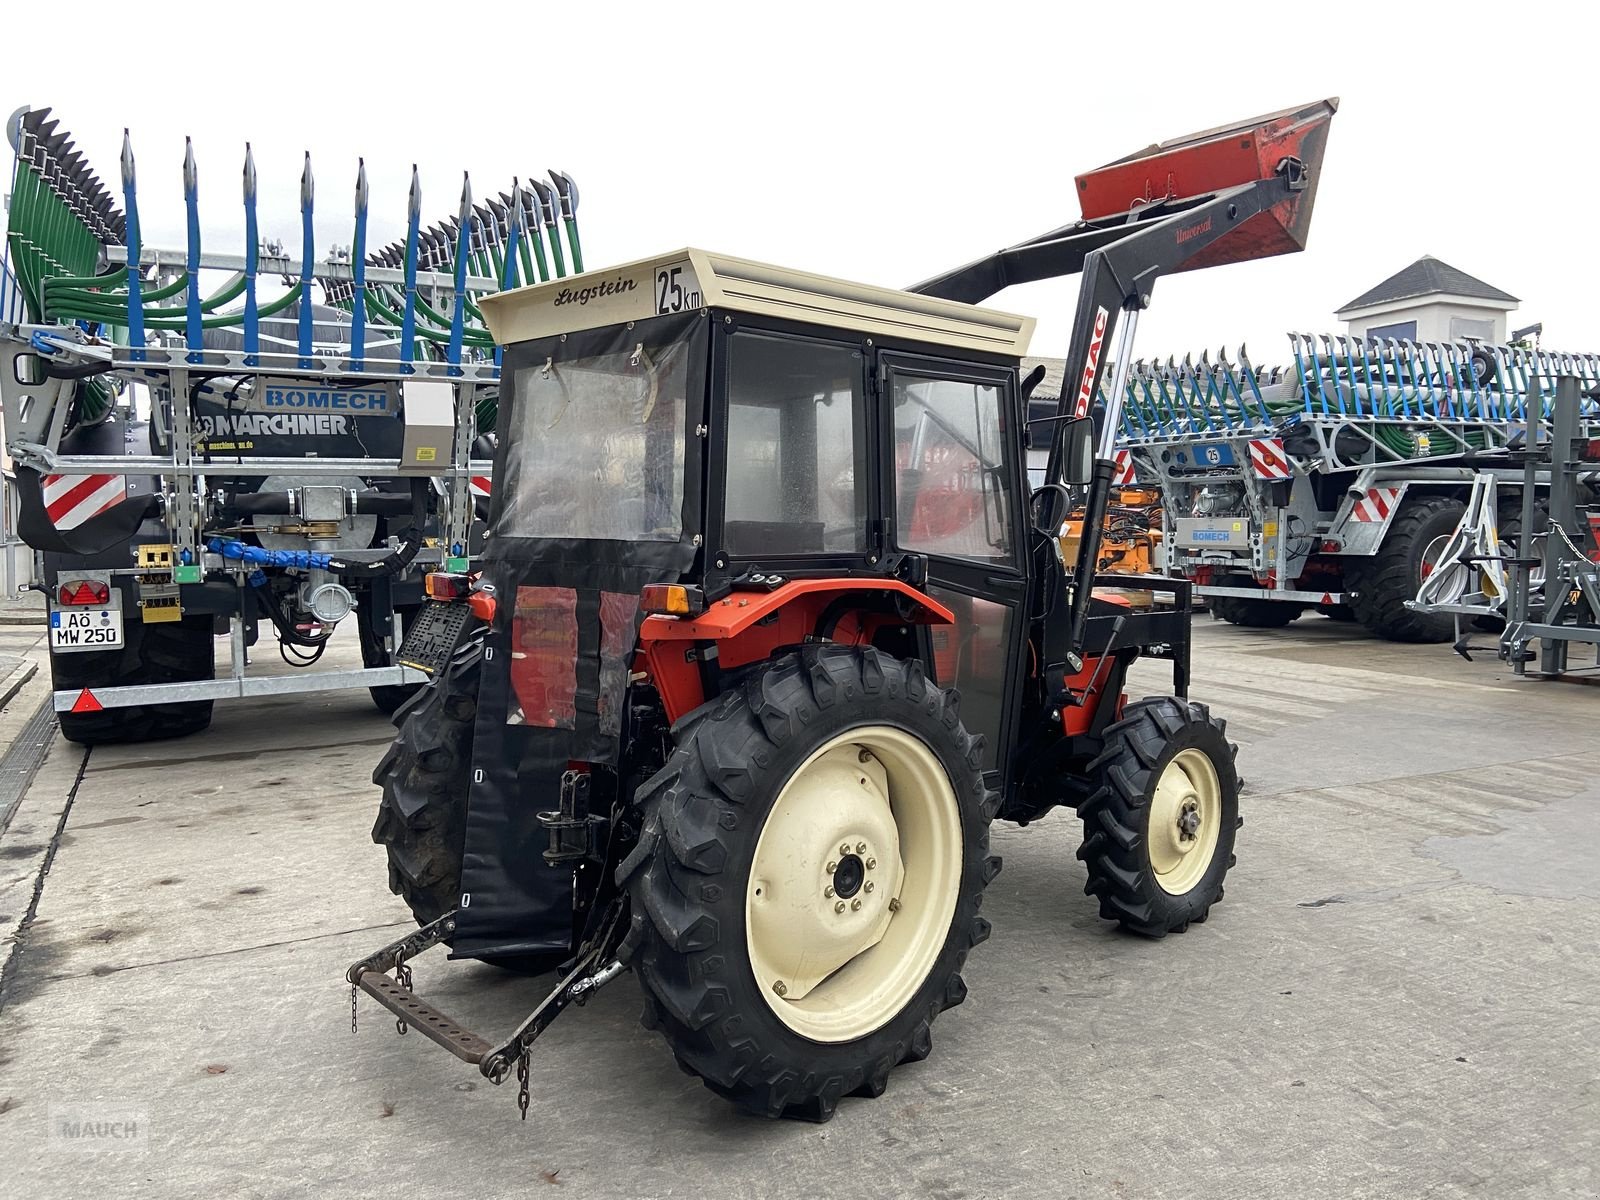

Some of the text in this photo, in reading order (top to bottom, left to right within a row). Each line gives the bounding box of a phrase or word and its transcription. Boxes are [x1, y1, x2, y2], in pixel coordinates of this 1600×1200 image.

[1175, 215, 1213, 245] Universal
[554, 276, 638, 306] Lugstein
[657, 266, 700, 314] 25 km
[266, 390, 387, 410] BOMECH
[216, 414, 348, 436] MARCHNER
[1207, 449, 1219, 461] 25
[1192, 531, 1230, 542] BOMECH
[68, 613, 91, 628] AÖ
[57, 628, 117, 645] MW 250
